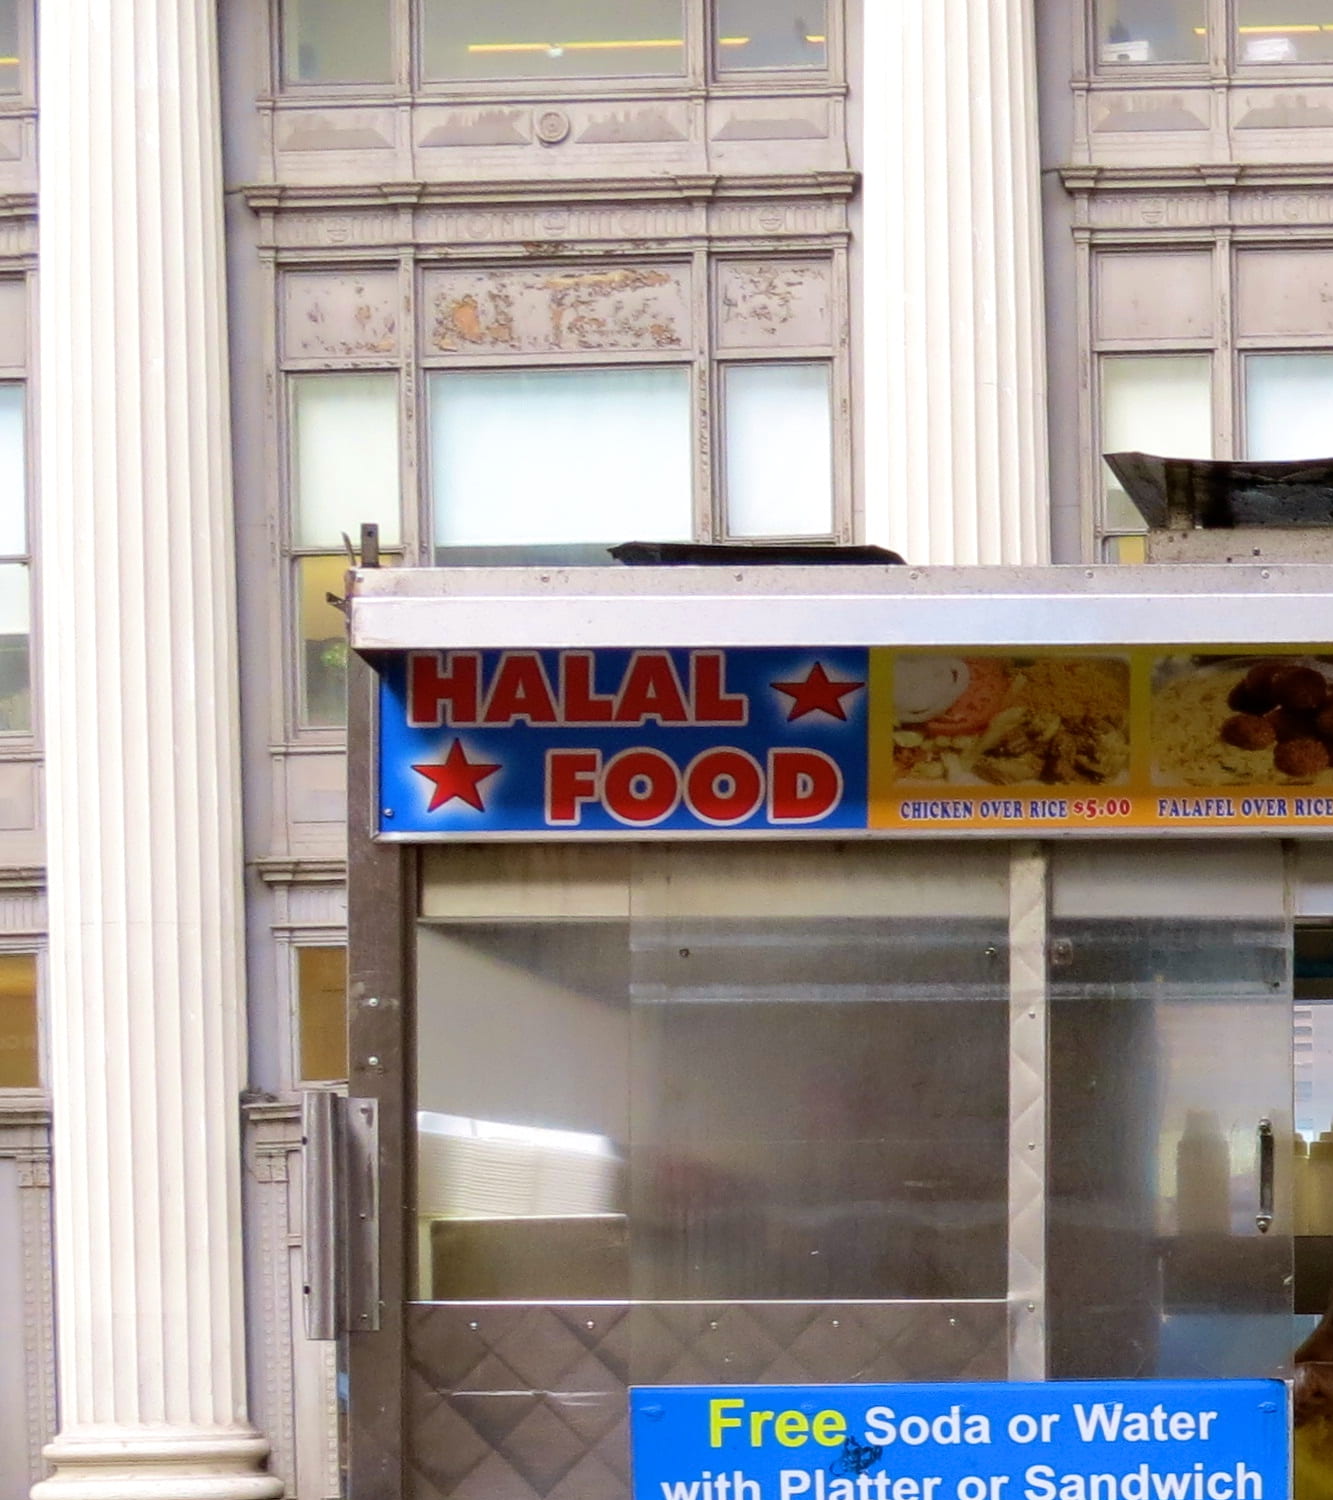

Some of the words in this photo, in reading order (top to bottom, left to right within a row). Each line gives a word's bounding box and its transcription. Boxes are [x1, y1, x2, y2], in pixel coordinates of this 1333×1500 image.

[408, 651, 748, 727] HALAL
[545, 748, 843, 824] FOOD
[900, 801, 972, 819] CHICKEN
[980, 800, 1023, 819] OVER
[1030, 800, 1067, 818] RICE
[1073, 799, 1132, 819] $5.00
[1158, 799, 1234, 817] FALAFEL
[1242, 799, 1288, 816] OVER
[709, 1399, 847, 1447] Free
[865, 1405, 990, 1446] Soda
[1008, 1410, 1059, 1444] or
[1072, 1403, 1217, 1442] Water
